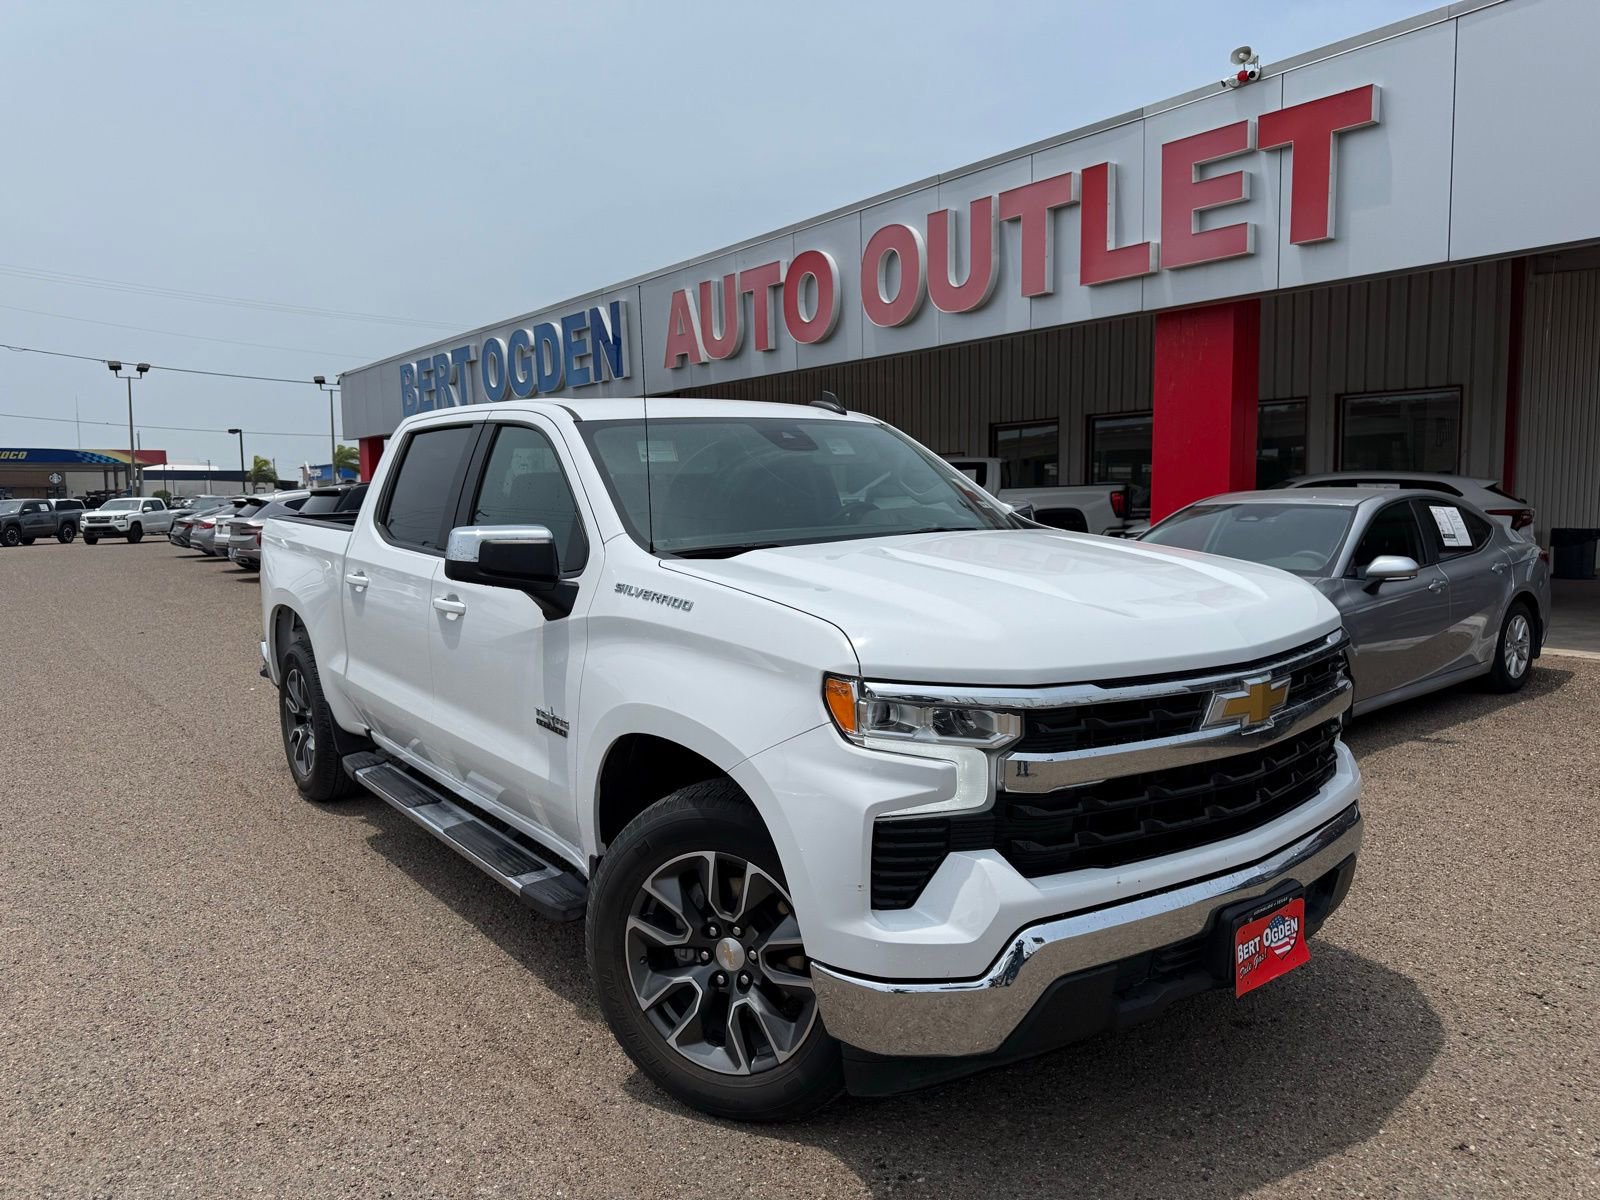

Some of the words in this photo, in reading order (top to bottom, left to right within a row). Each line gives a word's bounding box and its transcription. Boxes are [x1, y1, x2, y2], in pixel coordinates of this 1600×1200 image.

[400, 345, 476, 417] BERT
[481, 300, 630, 402] OGDEN
[663, 249, 841, 370] AUTO
[860, 83, 1382, 328] OUTLET
[0, 451, 28, 460] OCO
[614, 582, 694, 612] SILVERADO
[1237, 936, 1261, 964] BERT
[1263, 917, 1298, 947] OGDEN
